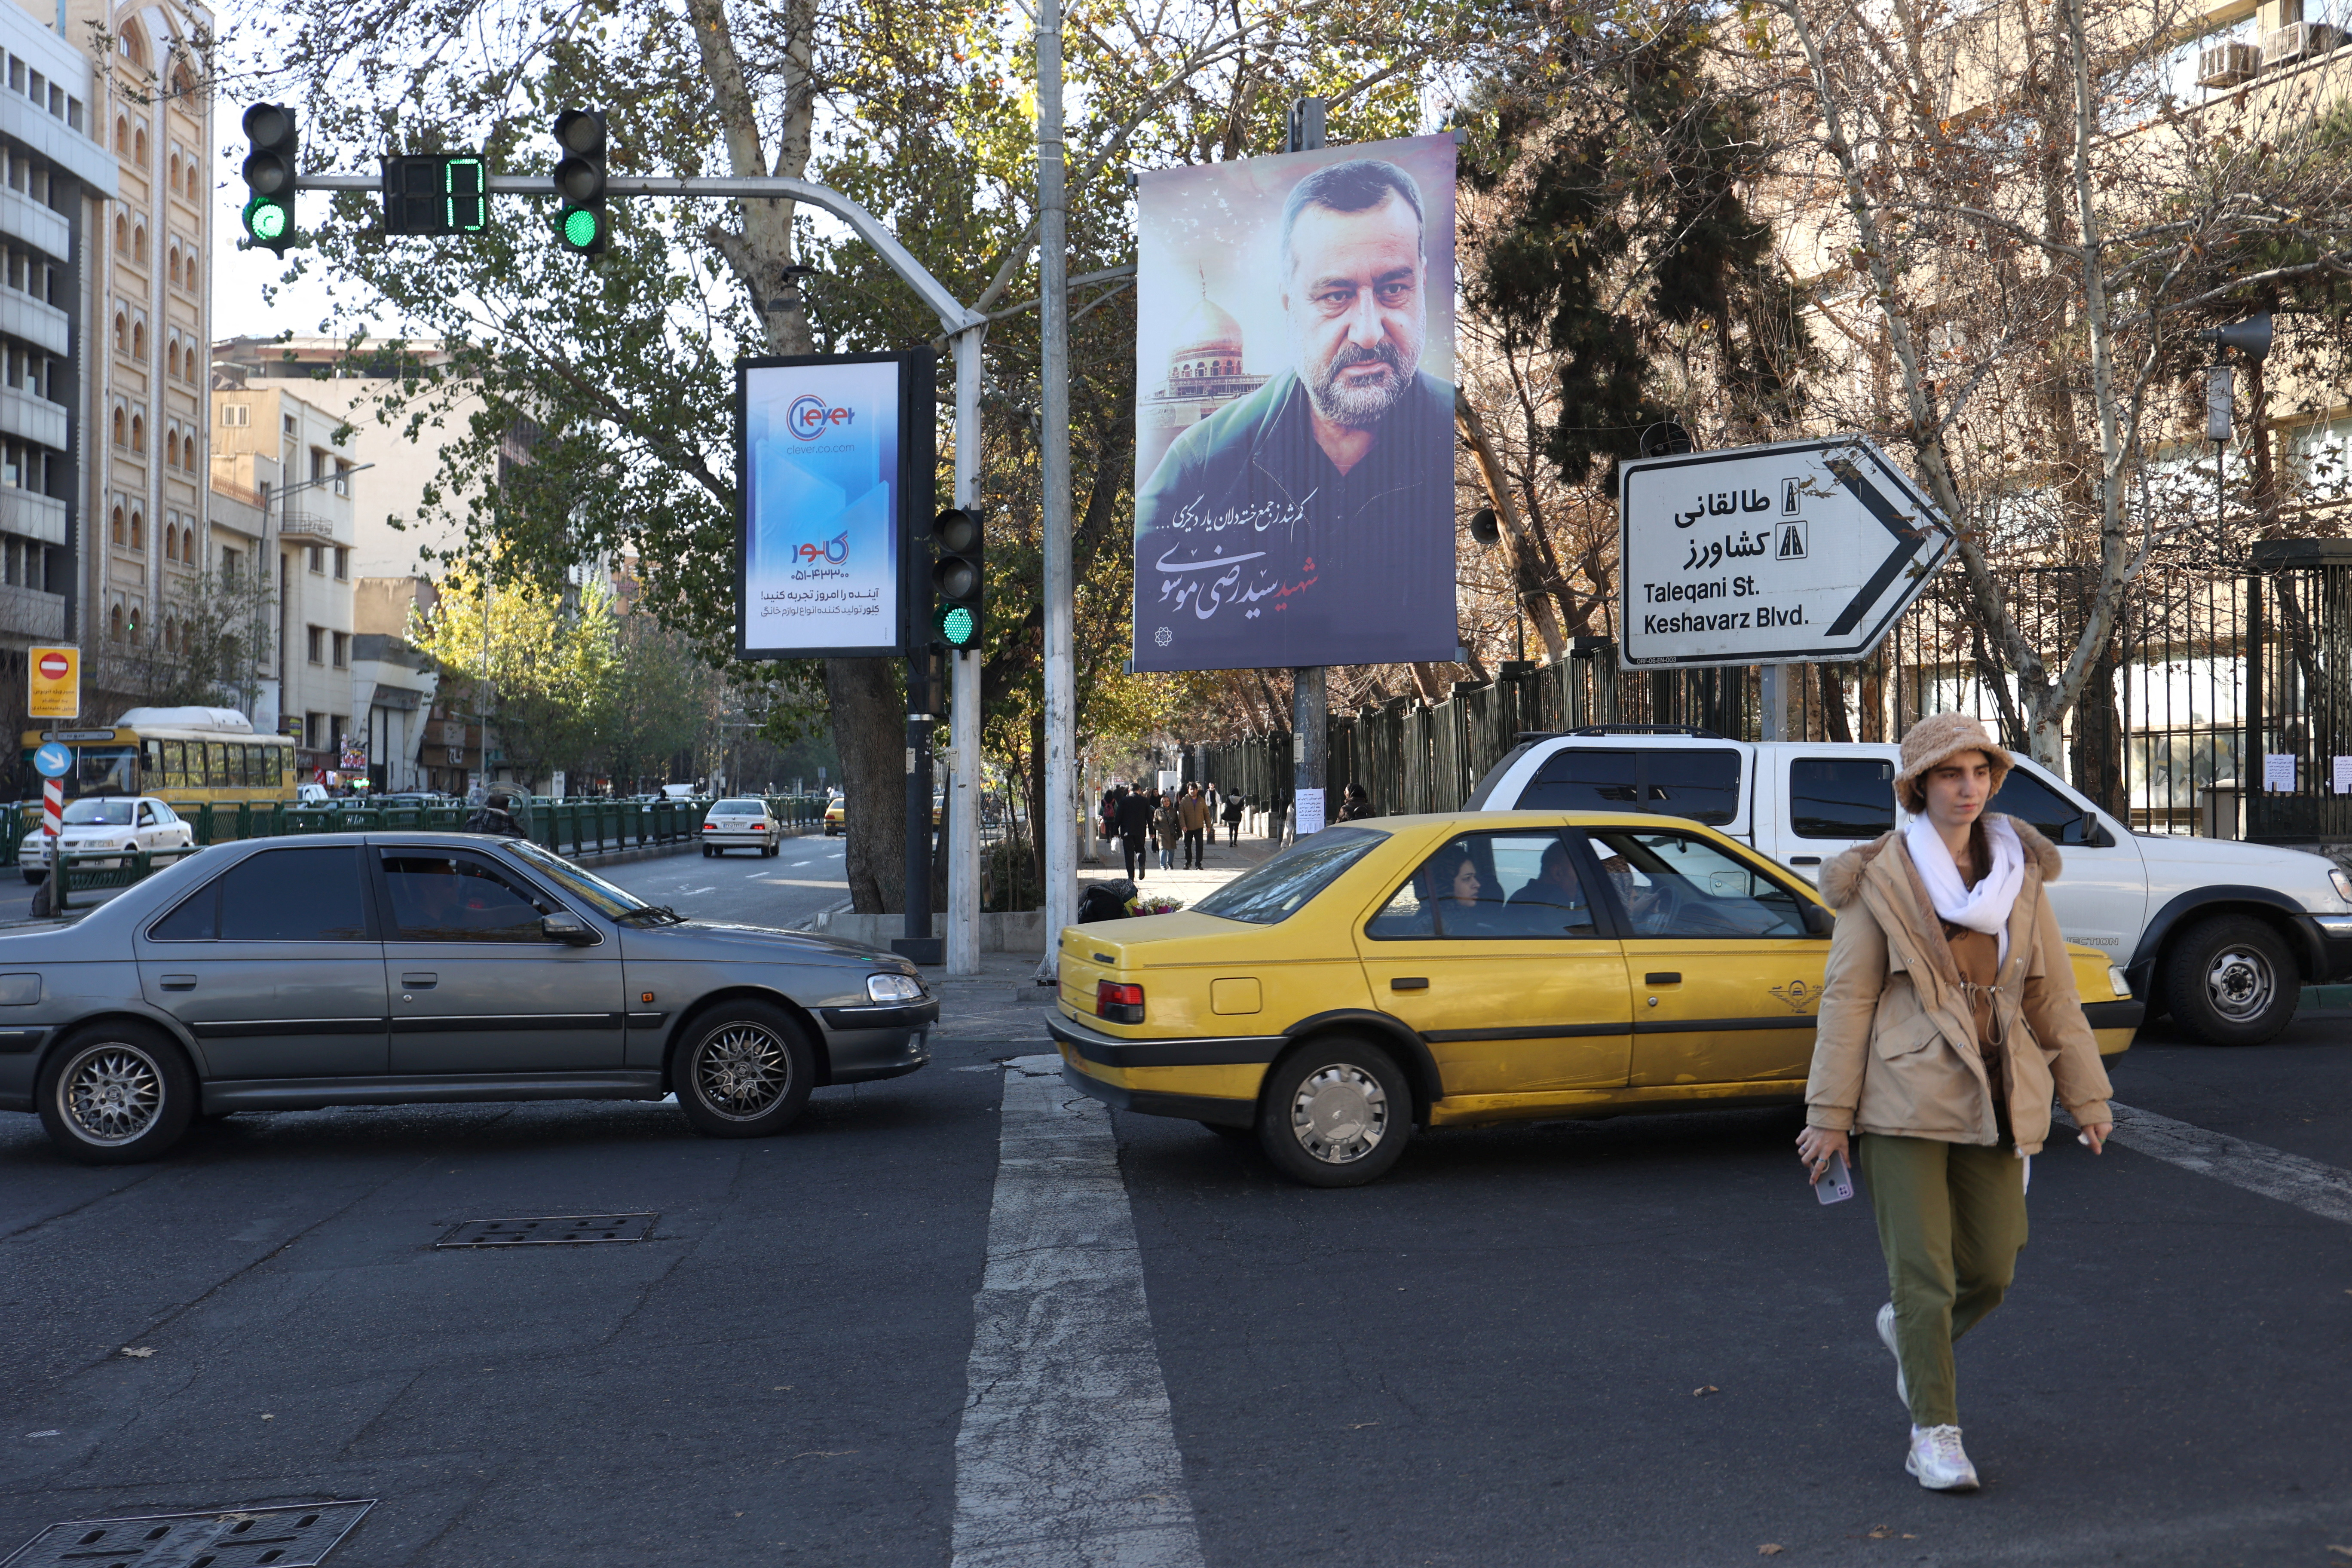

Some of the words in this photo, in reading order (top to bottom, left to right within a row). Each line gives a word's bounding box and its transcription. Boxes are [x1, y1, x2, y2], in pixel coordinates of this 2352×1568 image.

[787, 444, 855, 454] clever.co.com
[1675, 489, 1770, 528] طالقانی
[1683, 531, 1770, 570] کشاورز
[1271, 557, 1319, 611] شهید
[1644, 577, 1726, 603] Taleqani
[1733, 575, 1759, 597] St.
[787, 590, 814, 602] تجربه
[815, 589, 839, 601] امروز
[841, 589, 846, 600] را
[848, 588, 879, 600] آینده
[761, 606, 781, 617] خانگی
[782, 606, 798, 616] لوازم
[799, 606, 816, 616] انواع
[841, 605, 862, 616] تولید
[1645, 612, 1750, 634] Keshavarz
[1757, 604, 1809, 627] Blvd.
